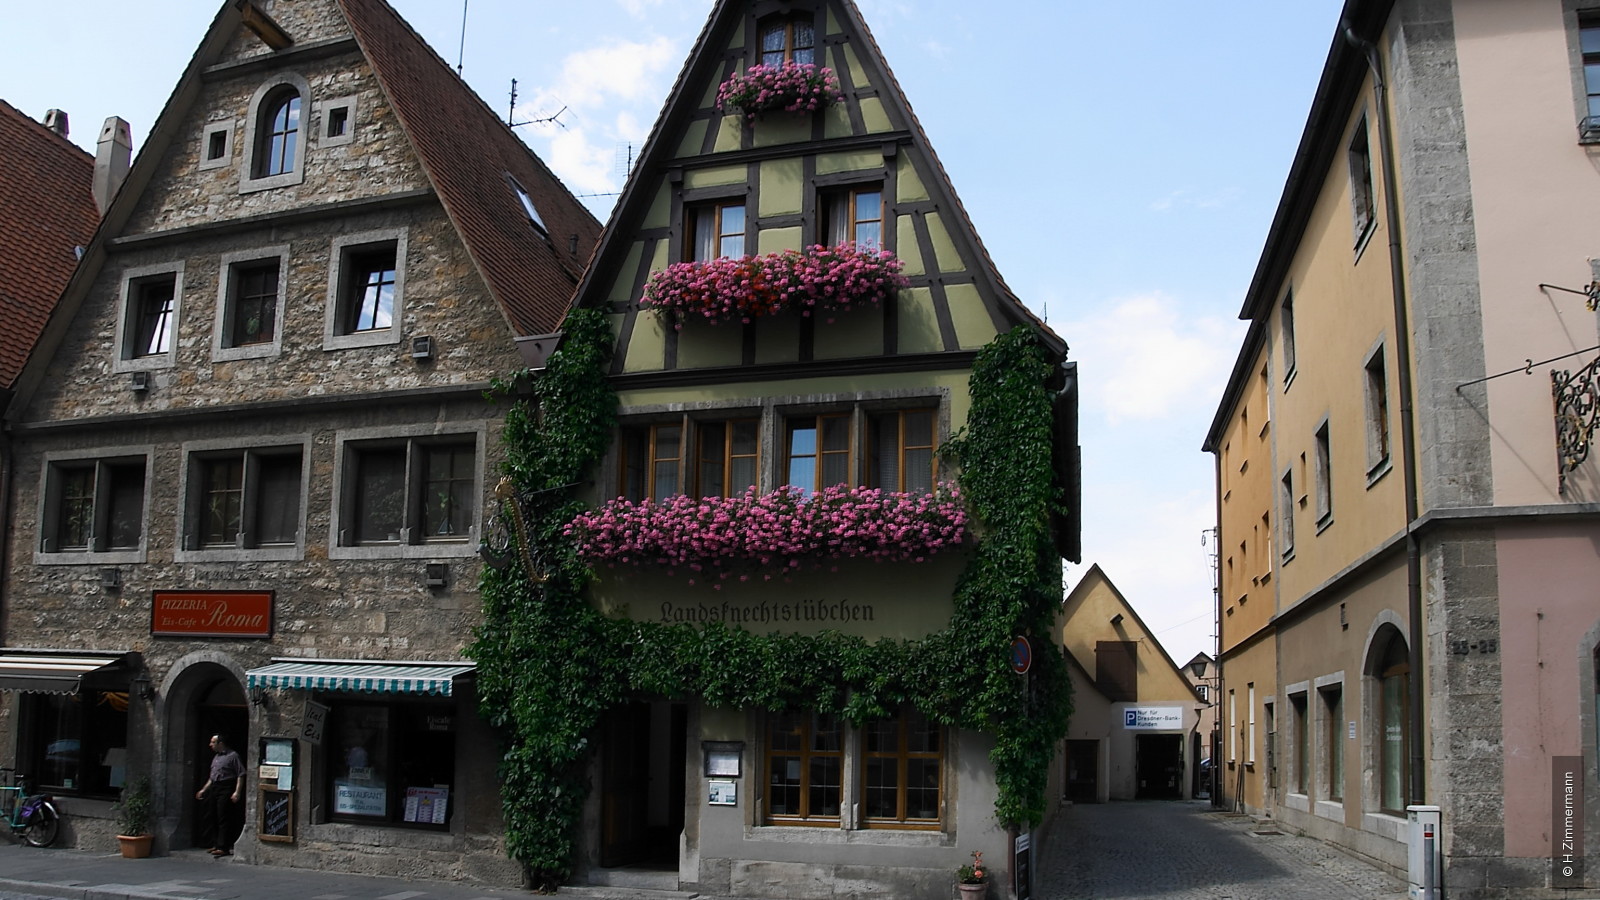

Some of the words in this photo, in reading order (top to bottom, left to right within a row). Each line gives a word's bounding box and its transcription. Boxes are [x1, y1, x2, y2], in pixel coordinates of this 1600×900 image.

[160, 599, 207, 610] PIZZERIA
[201, 600, 263, 627] Roma
[659, 599, 875, 625] Landsknechtstübchen
[1127, 712, 1136, 725] P
[338, 790, 383, 800] RESTAURANT
